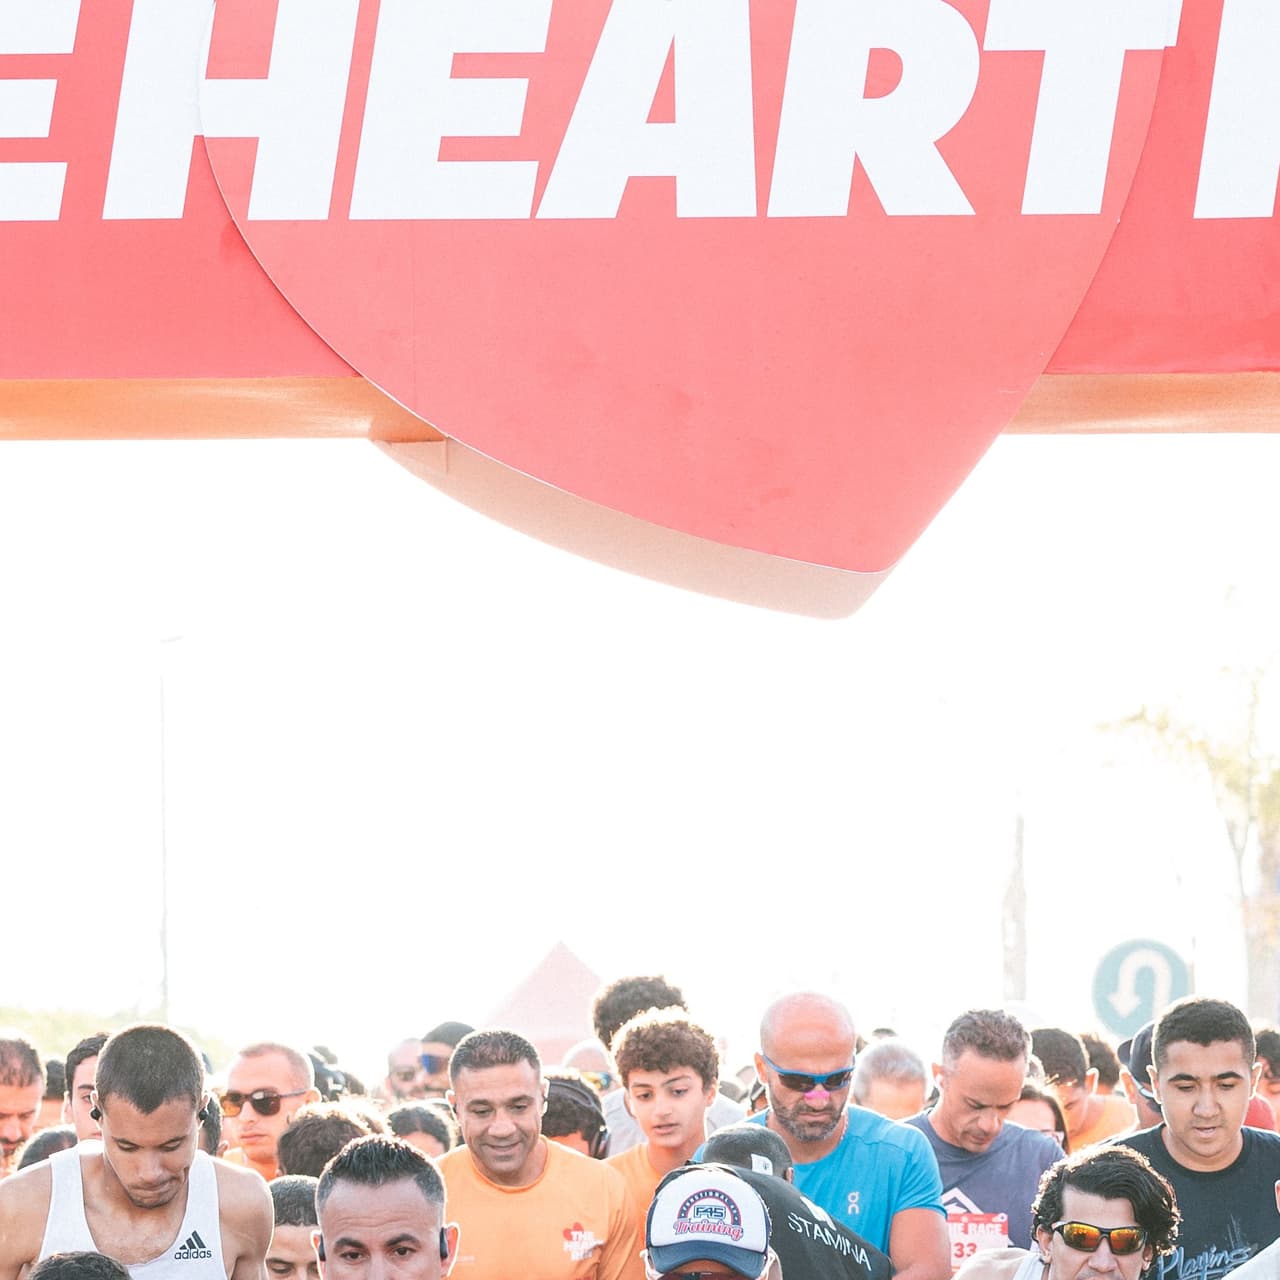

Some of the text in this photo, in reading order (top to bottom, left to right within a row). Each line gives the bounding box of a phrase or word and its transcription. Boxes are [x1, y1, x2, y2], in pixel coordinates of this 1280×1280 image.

[102, 0, 1185, 220] HEART
[174, 1248, 212, 1260] adidas
[787, 1211, 872, 1272] STAMINA
